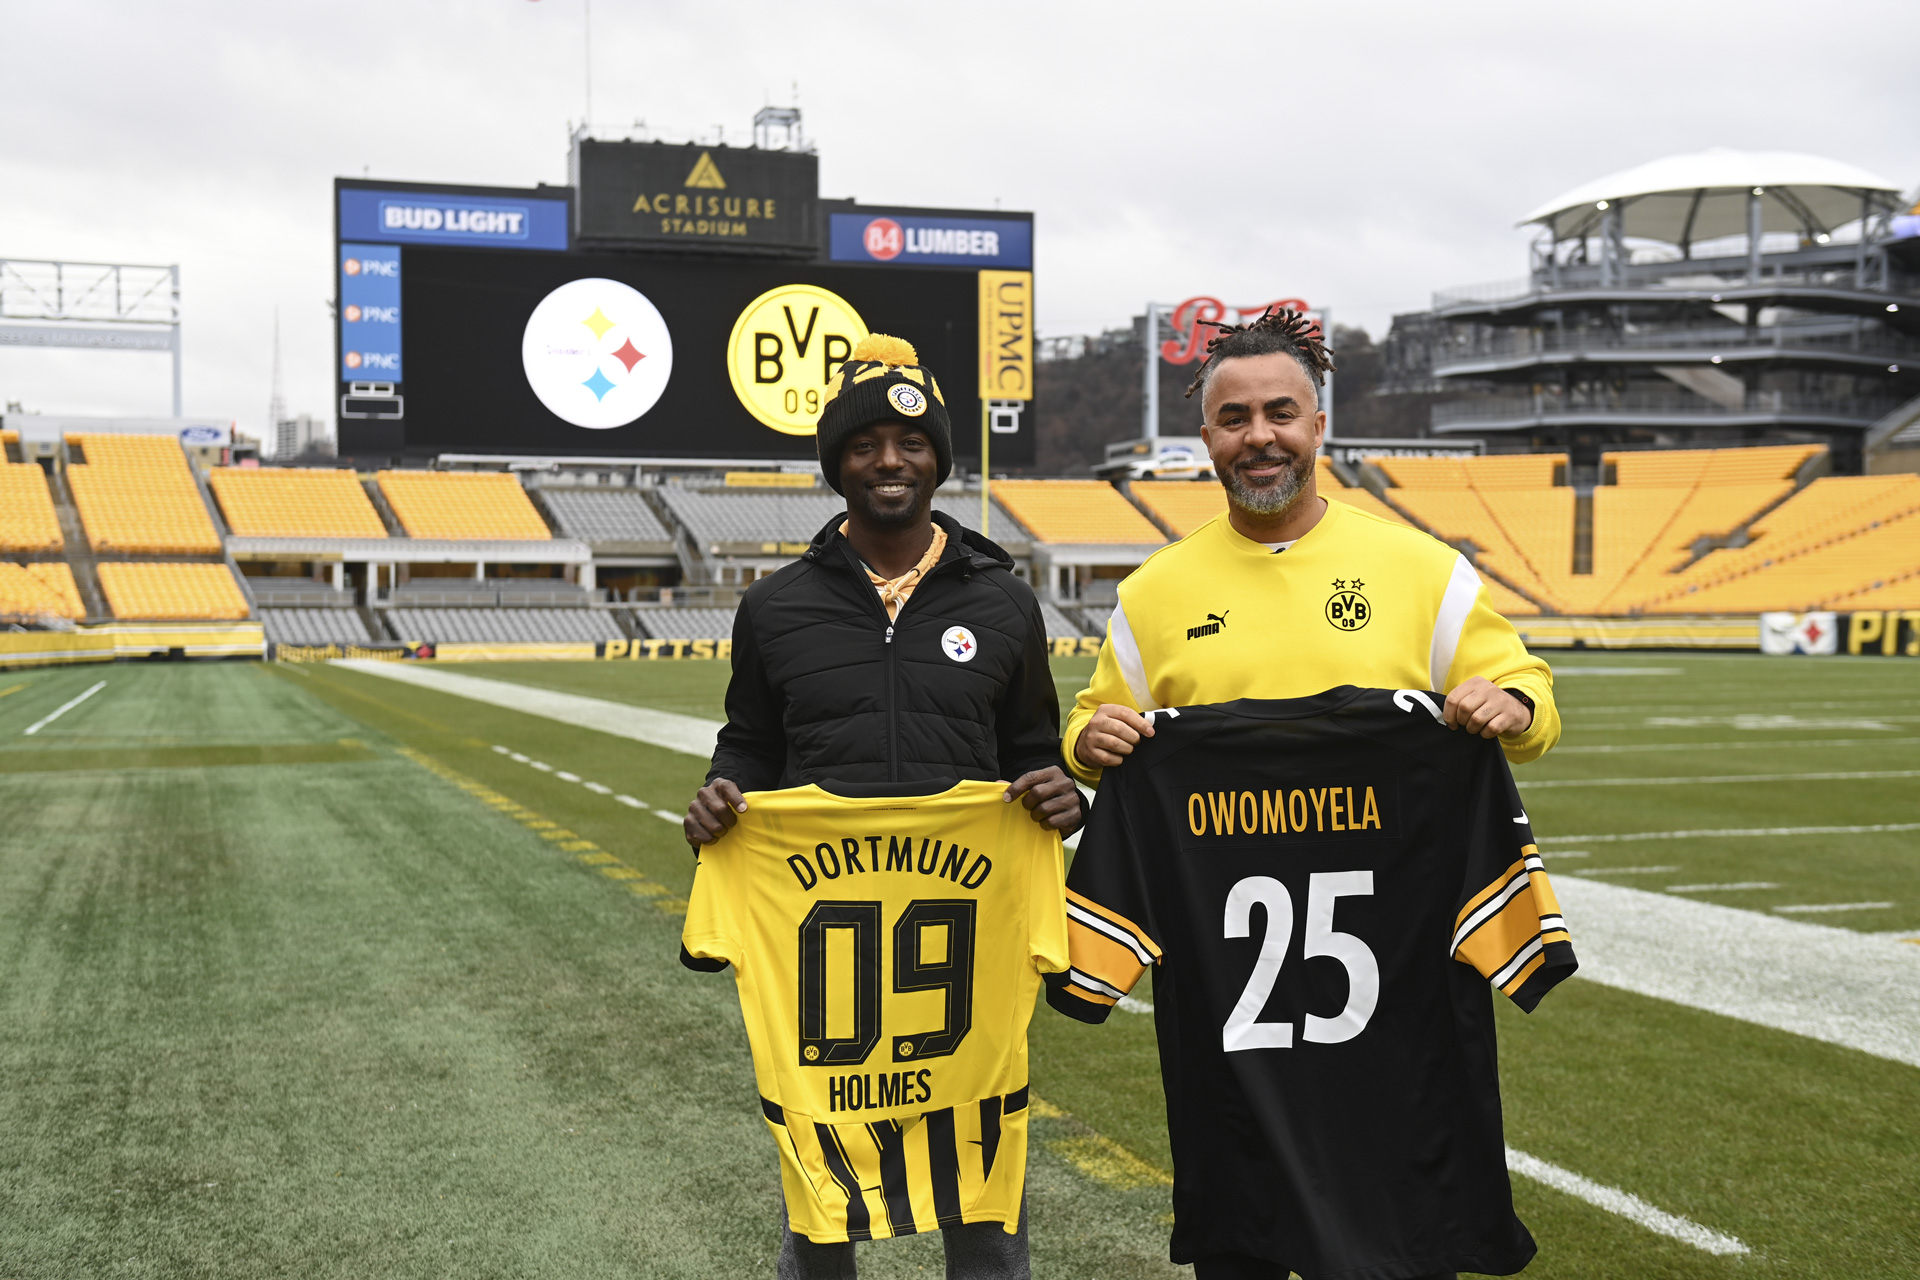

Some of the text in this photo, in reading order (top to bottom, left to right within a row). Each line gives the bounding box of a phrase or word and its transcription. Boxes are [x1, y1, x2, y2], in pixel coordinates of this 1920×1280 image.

[384, 206, 524, 235] BUD LIGHT
[632, 193, 776, 219] ACRISURE
[661, 217, 748, 236] STADIUM
[868, 226, 1000, 256] 84 LUMBER
[362, 259, 399, 277] PNC
[363, 306, 399, 324] PNC
[755, 305, 852, 386] BVB
[997, 282, 1026, 391] UPMC
[363, 352, 400, 370] PNC
[785, 388, 818, 414] 09
[1331, 594, 1367, 620] BVB
[1187, 622, 1220, 641] PUMA
[1187, 786, 1382, 836] OWOMOYELA
[786, 835, 993, 892] DORTMUND
[1222, 870, 1380, 1053] 25
[798, 899, 978, 1067] 09
[829, 1068, 932, 1112] HOLMES
